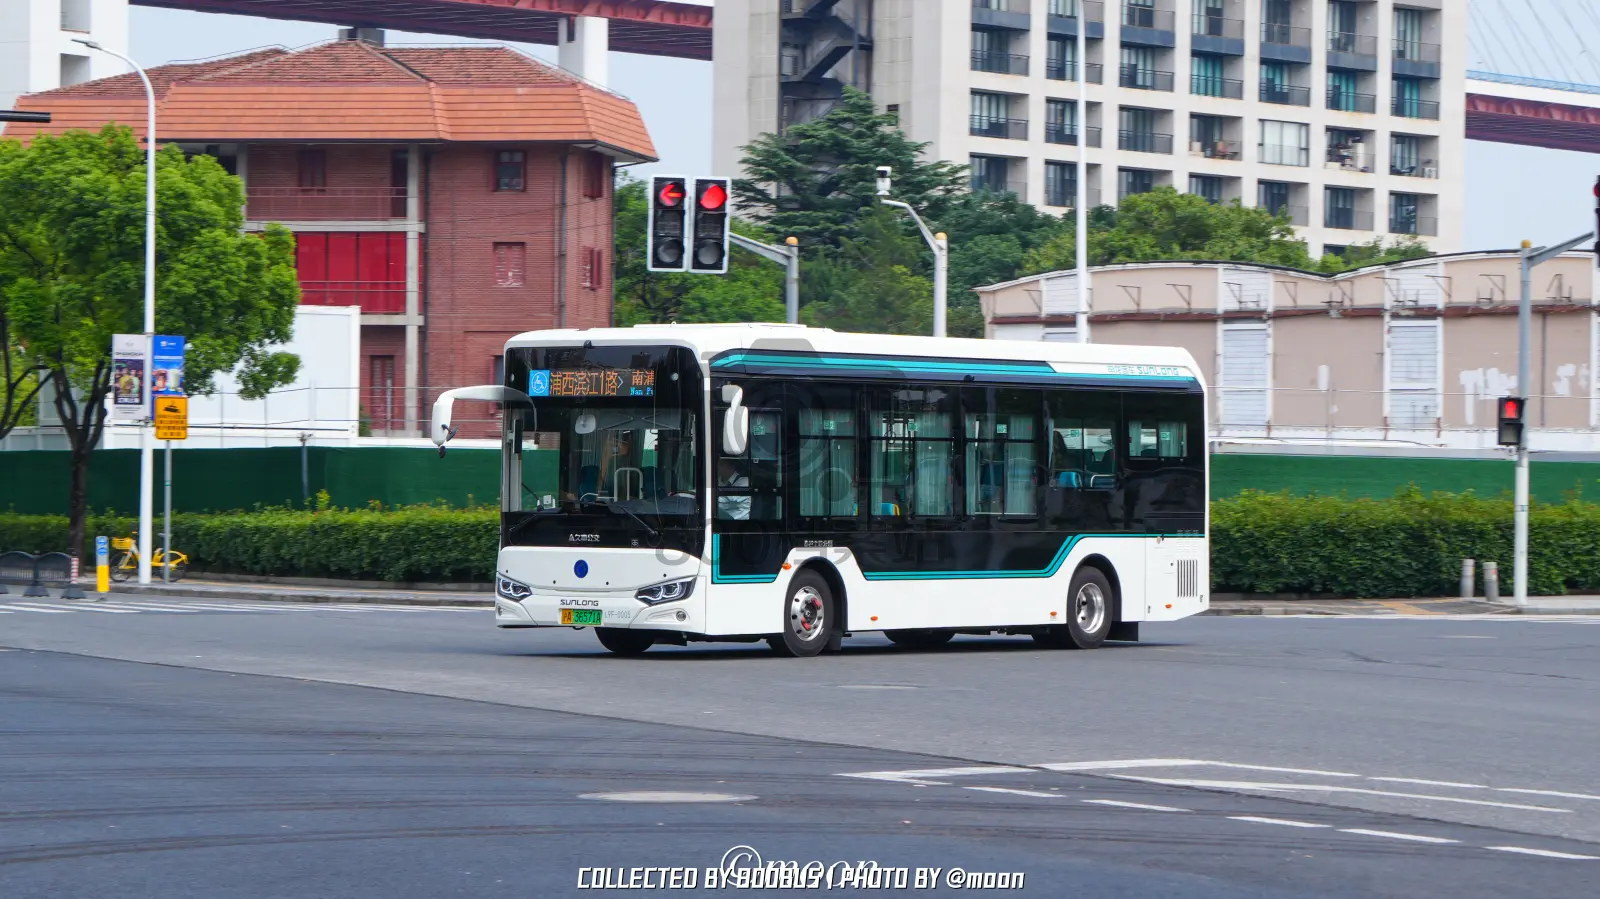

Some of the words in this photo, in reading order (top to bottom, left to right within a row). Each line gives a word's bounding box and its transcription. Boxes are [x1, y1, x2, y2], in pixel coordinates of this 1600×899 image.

[1137, 366, 1178, 375] SUNLONG
[550, 370, 617, 395] 浦西滨江1路
[632, 370, 654, 385] 南浦
[629, 387, 643, 395] Nan
